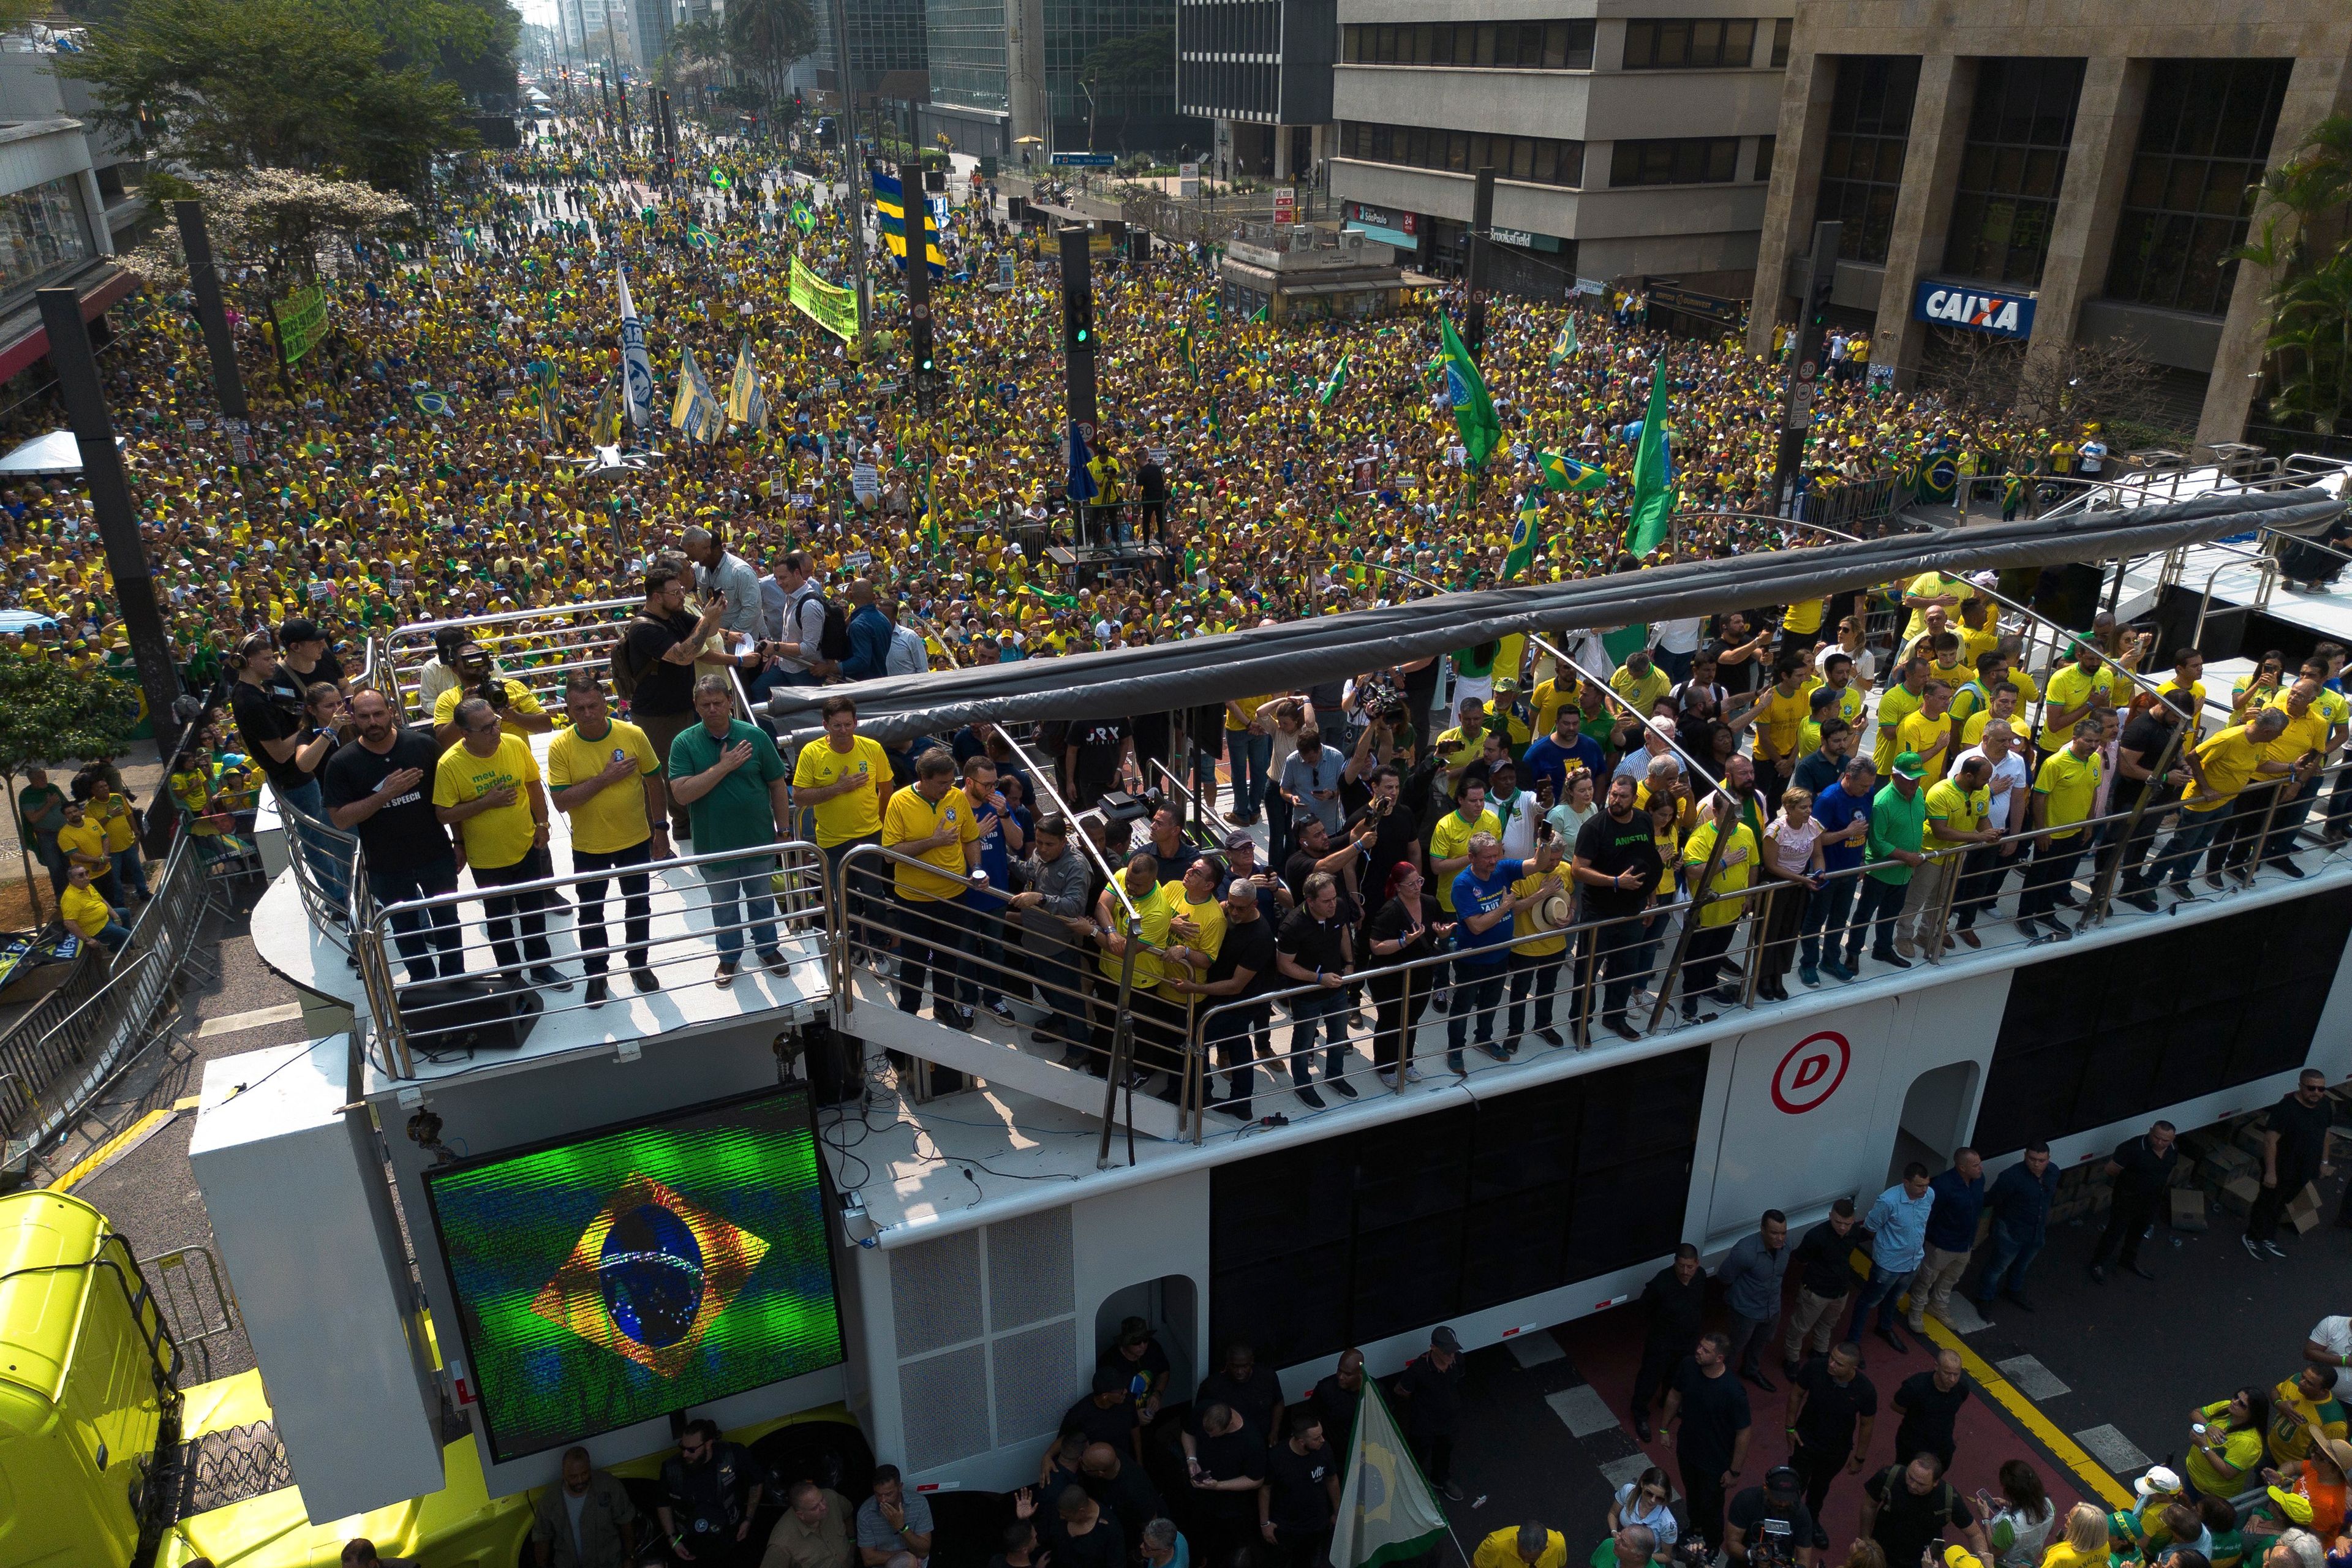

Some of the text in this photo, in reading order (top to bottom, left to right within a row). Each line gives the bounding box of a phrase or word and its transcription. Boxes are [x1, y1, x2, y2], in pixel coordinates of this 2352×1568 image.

[1404, 216, 1412, 225] 24
[1926, 290, 2018, 331] CAIXA
[1802, 364, 1814, 374] 50
[472, 770, 496, 783] meu
[476, 774, 513, 794] partido
[391, 791, 421, 807] SPEECH
[1616, 834, 1649, 846] ANISTIA
[1791, 1054, 1830, 1090] D
